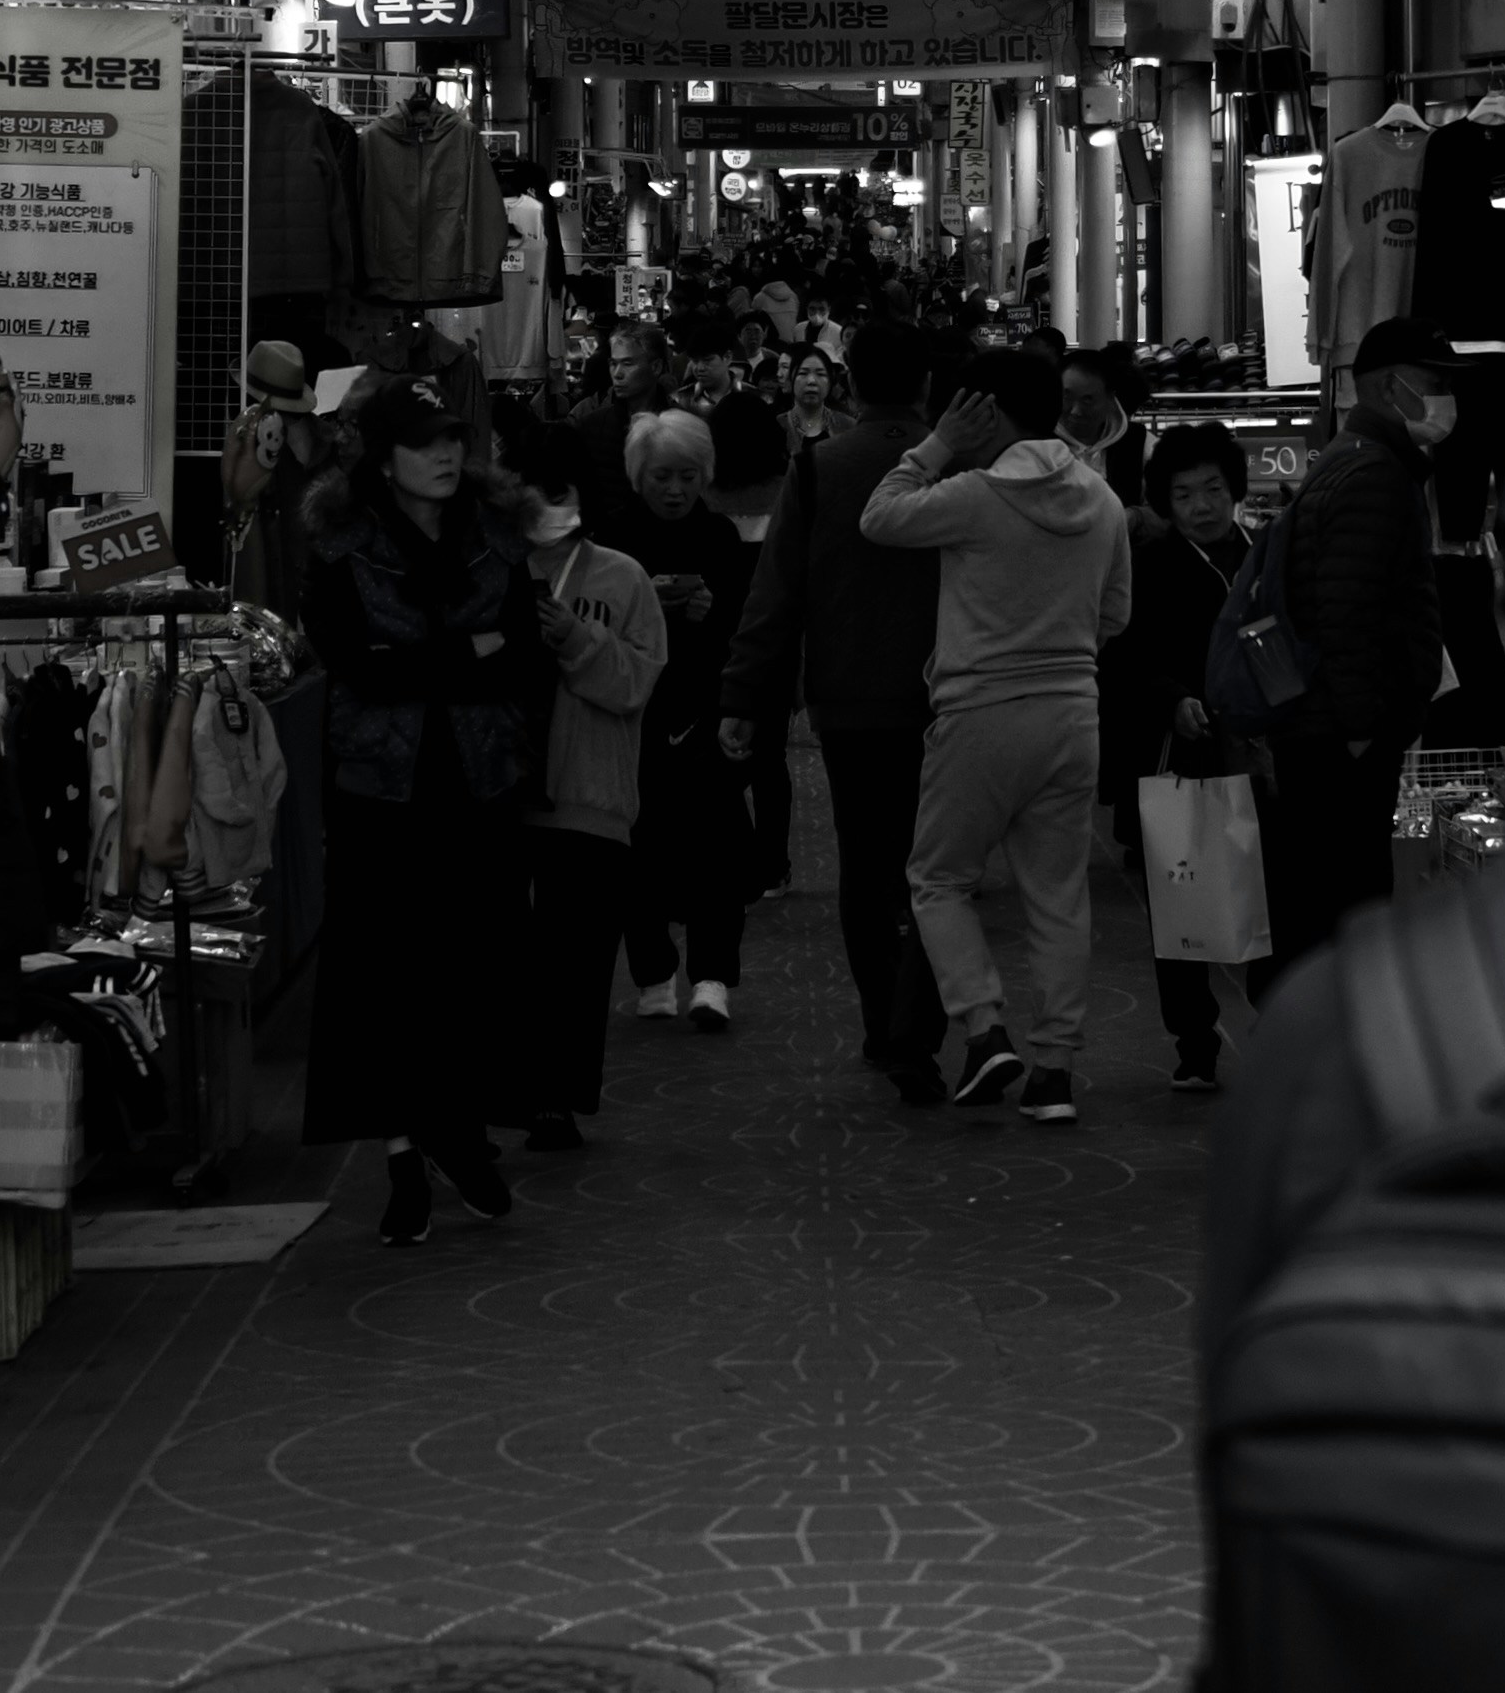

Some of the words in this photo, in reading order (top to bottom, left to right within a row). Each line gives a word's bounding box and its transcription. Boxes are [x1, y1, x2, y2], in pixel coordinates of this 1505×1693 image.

[724, 1, 890, 31] 팔달문시장은
[653, 38, 732, 68] 소독을
[740, 36, 853, 68] 철저하게
[860, 36, 915, 68] 하고
[924, 34, 1044, 67] 있습니다.
[60, 56, 161, 91] 전문점
[19, 117, 46, 134] 인기
[49, 118, 106, 136] 광고상품
[16, 138, 57, 155] 가격의
[62, 139, 105, 155] 도소매
[21, 183, 82, 200] 기능식품
[60, 319, 91, 336] 차류
[50, 443, 66, 459] 환
[77, 524, 162, 571] SALE
